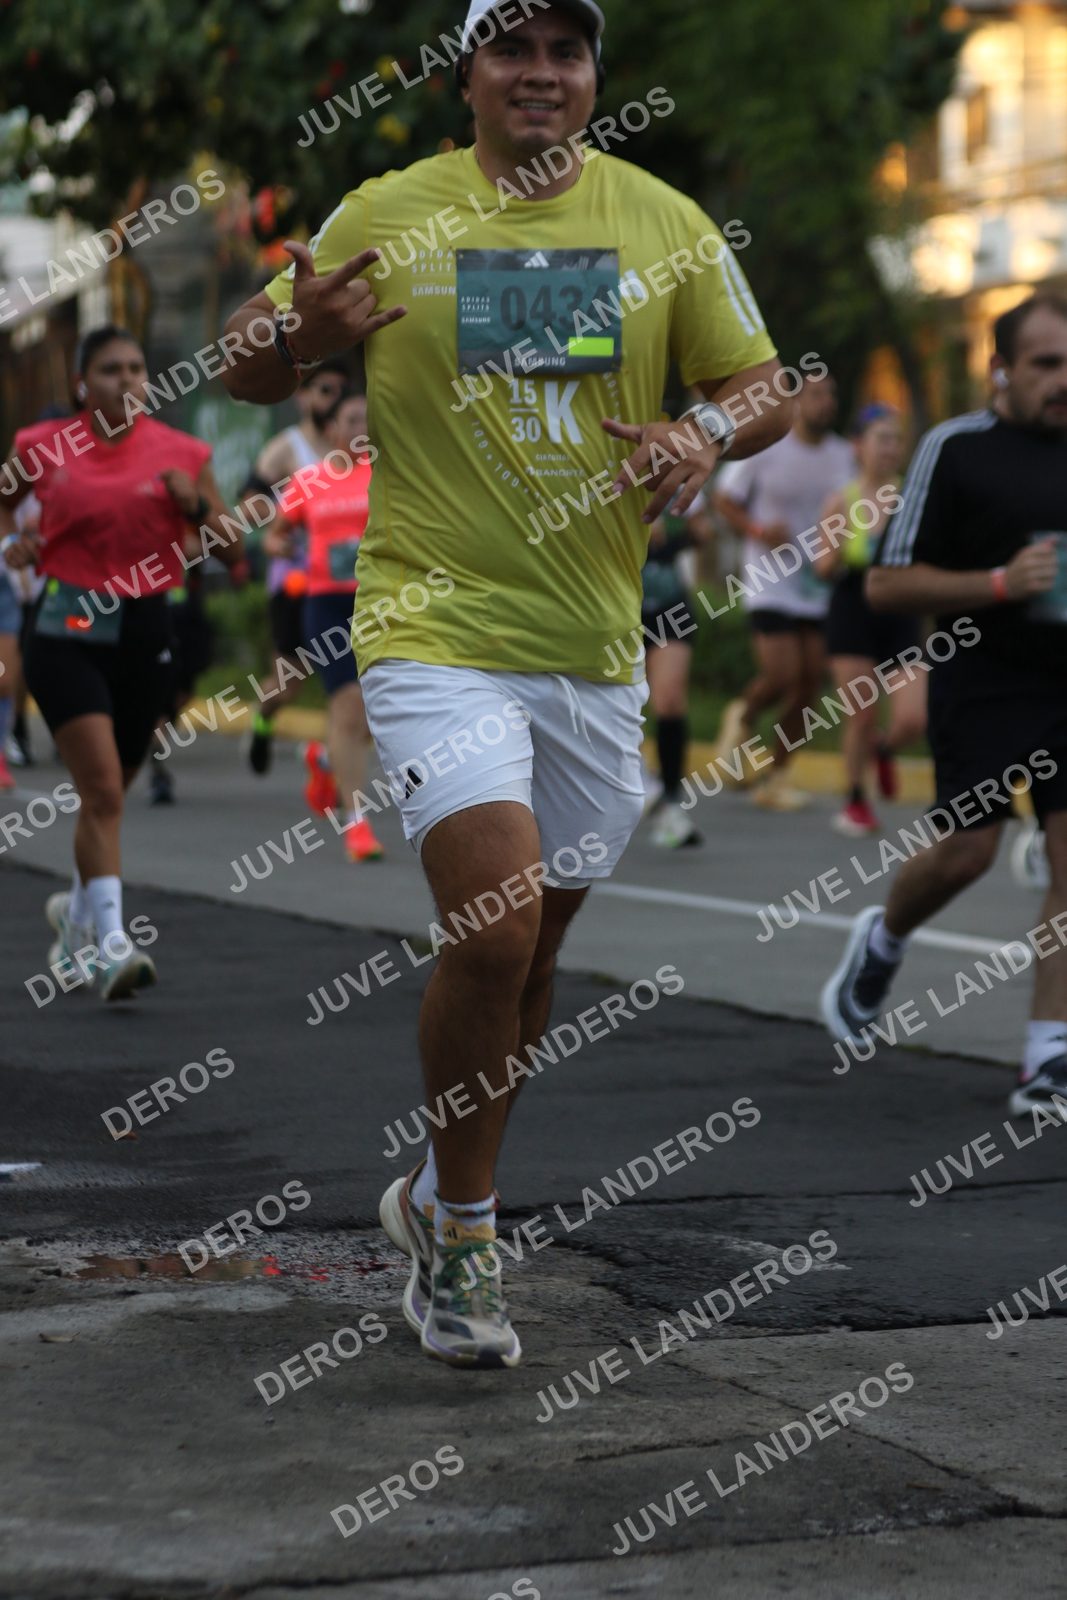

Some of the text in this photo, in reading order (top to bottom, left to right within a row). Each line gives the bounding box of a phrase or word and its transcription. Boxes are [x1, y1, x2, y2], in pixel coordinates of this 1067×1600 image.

[412, 263, 453, 273] SPLIT
[412, 286, 456, 297] SAMSUN
[510, 379, 537, 405] 15
[544, 380, 584, 444] K
[511, 416, 541, 442] 30
